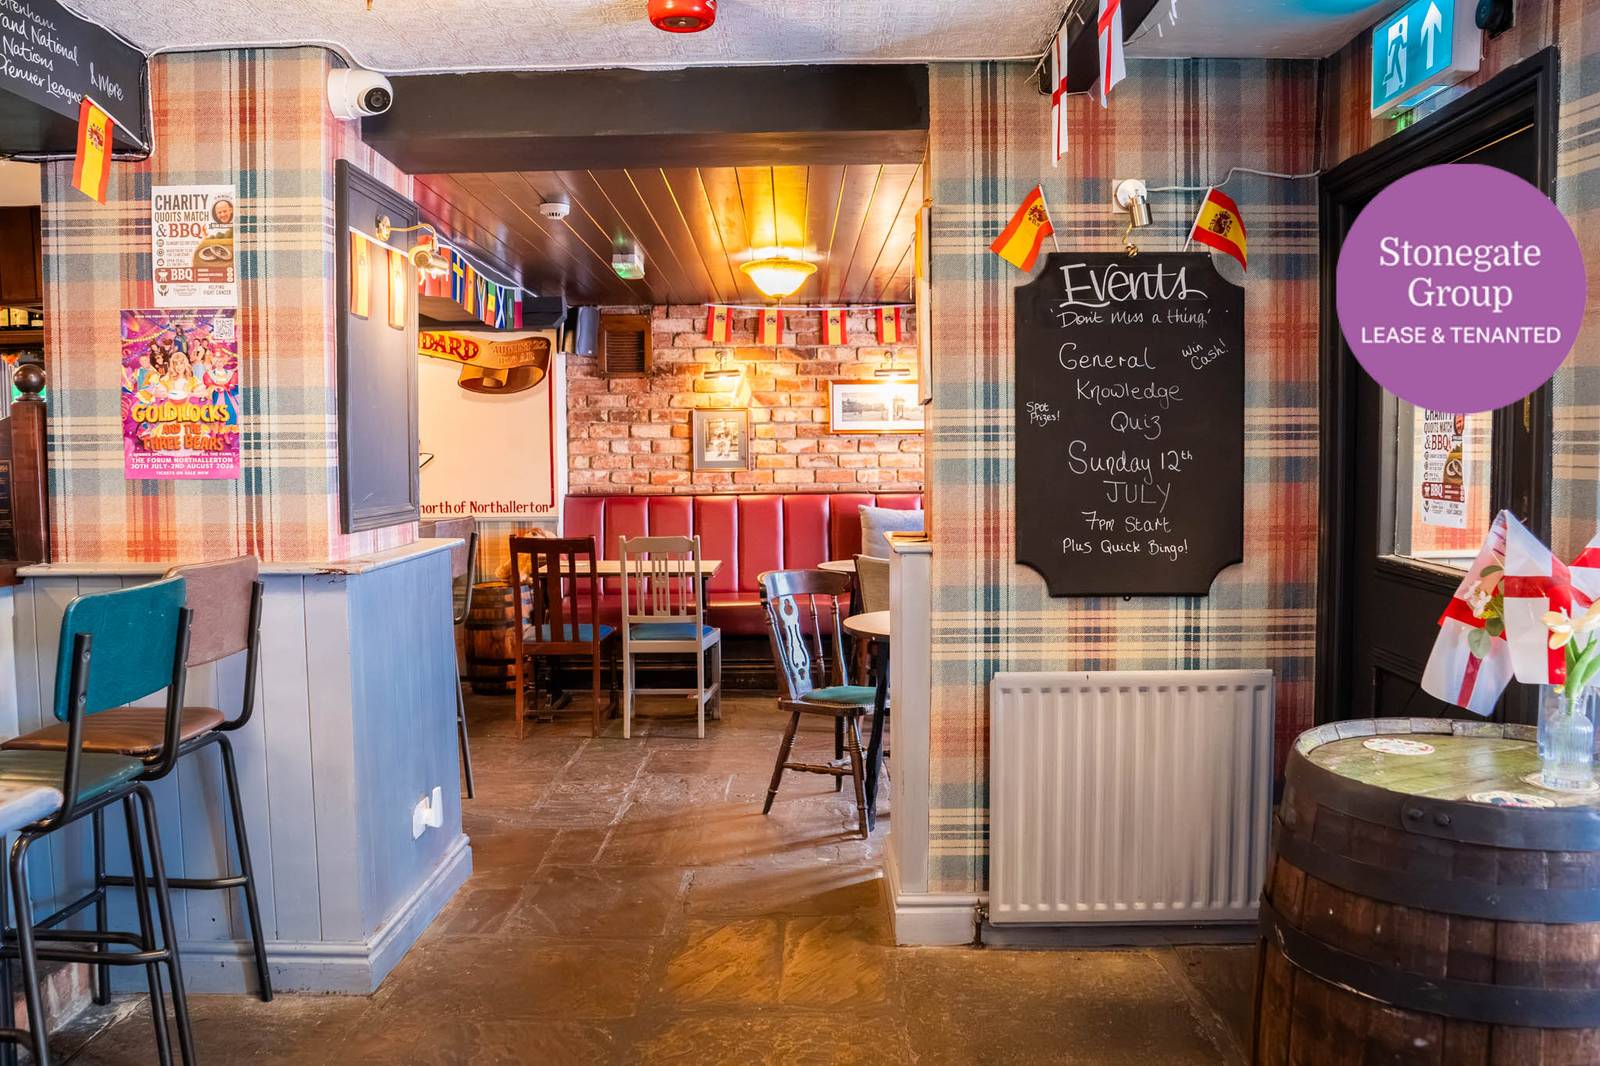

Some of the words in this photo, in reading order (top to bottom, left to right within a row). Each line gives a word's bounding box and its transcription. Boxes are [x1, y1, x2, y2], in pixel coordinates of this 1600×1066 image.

[3, 35, 53, 71] Nations
[31, 25, 79, 66] National
[155, 194, 208, 211] CHARITY
[154, 211, 181, 223] QUOITS
[184, 211, 209, 222] MATCH
[156, 224, 167, 238] &
[169, 223, 203, 239] BBQ
[171, 268, 193, 282] BBQ
[1059, 263, 1208, 307] Events
[1152, 313, 1161, 324] a
[420, 332, 479, 361] DARD
[1058, 342, 1156, 370] General
[1076, 378, 1183, 410] Knowledge
[131, 402, 230, 423] GOLDILOCKS
[1026, 402, 1050, 412] Spot
[161, 423, 180, 435] AND
[1110, 411, 1161, 440] Quiz
[143, 435, 180, 451] THREE
[184, 433, 224, 451] BEARS
[1432, 434, 1449, 452] BBQ
[1068, 440, 1153, 485] Sunday
[1103, 480, 1171, 513] JULY
[454, 501, 467, 514] of
[469, 501, 549, 514] Northallerton
[1081, 511, 1114, 531] 7pm
[1125, 516, 1172, 533] Start
[1063, 538, 1093, 553] Plus
[1101, 539, 1140, 554] Quick
[1148, 539, 1188, 561] Bingo!
